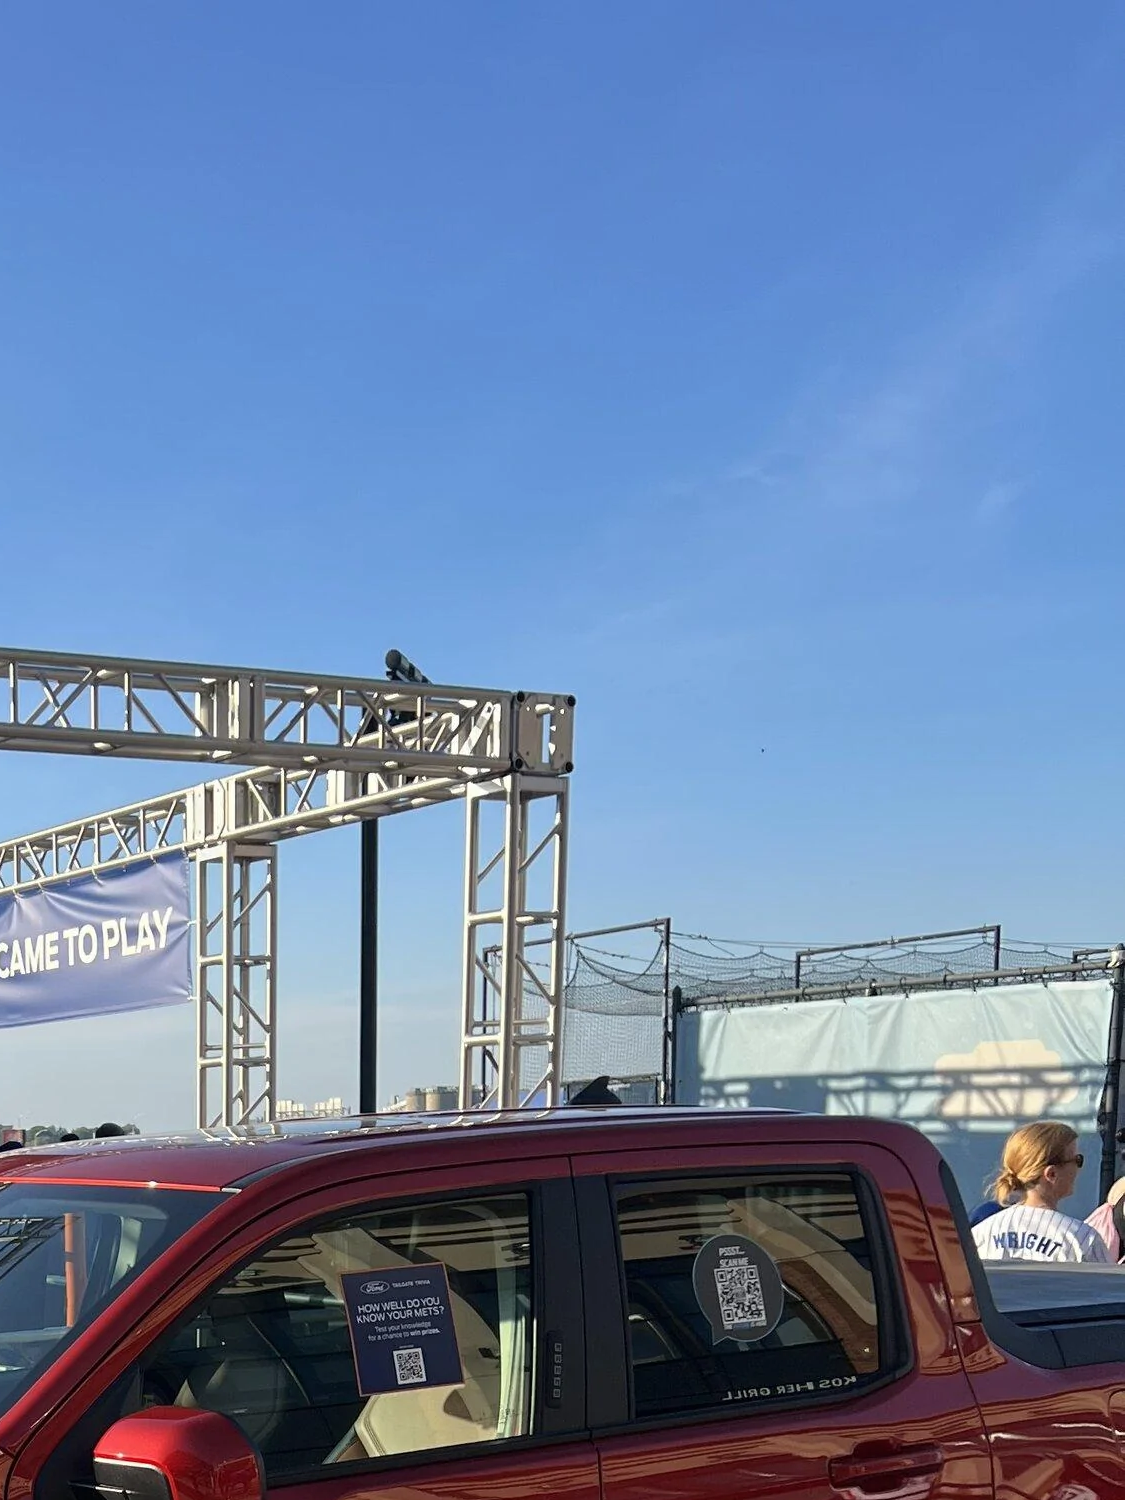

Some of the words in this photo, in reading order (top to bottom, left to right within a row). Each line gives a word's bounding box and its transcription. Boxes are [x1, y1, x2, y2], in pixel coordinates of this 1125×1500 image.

[63, 924, 99, 966] TO
[102, 906, 173, 960] PLAY
[993, 1231, 1063, 1258] WRIGHT
[356, 1313, 385, 1324] KNOW
[386, 1309, 413, 1320] YOUR
[414, 1306, 445, 1317] METS?
[357, 1303, 380, 1314] HOW
[381, 1301, 406, 1311] WELL
[407, 1299, 420, 1308] DO
[420, 1297, 440, 1306] YOU
